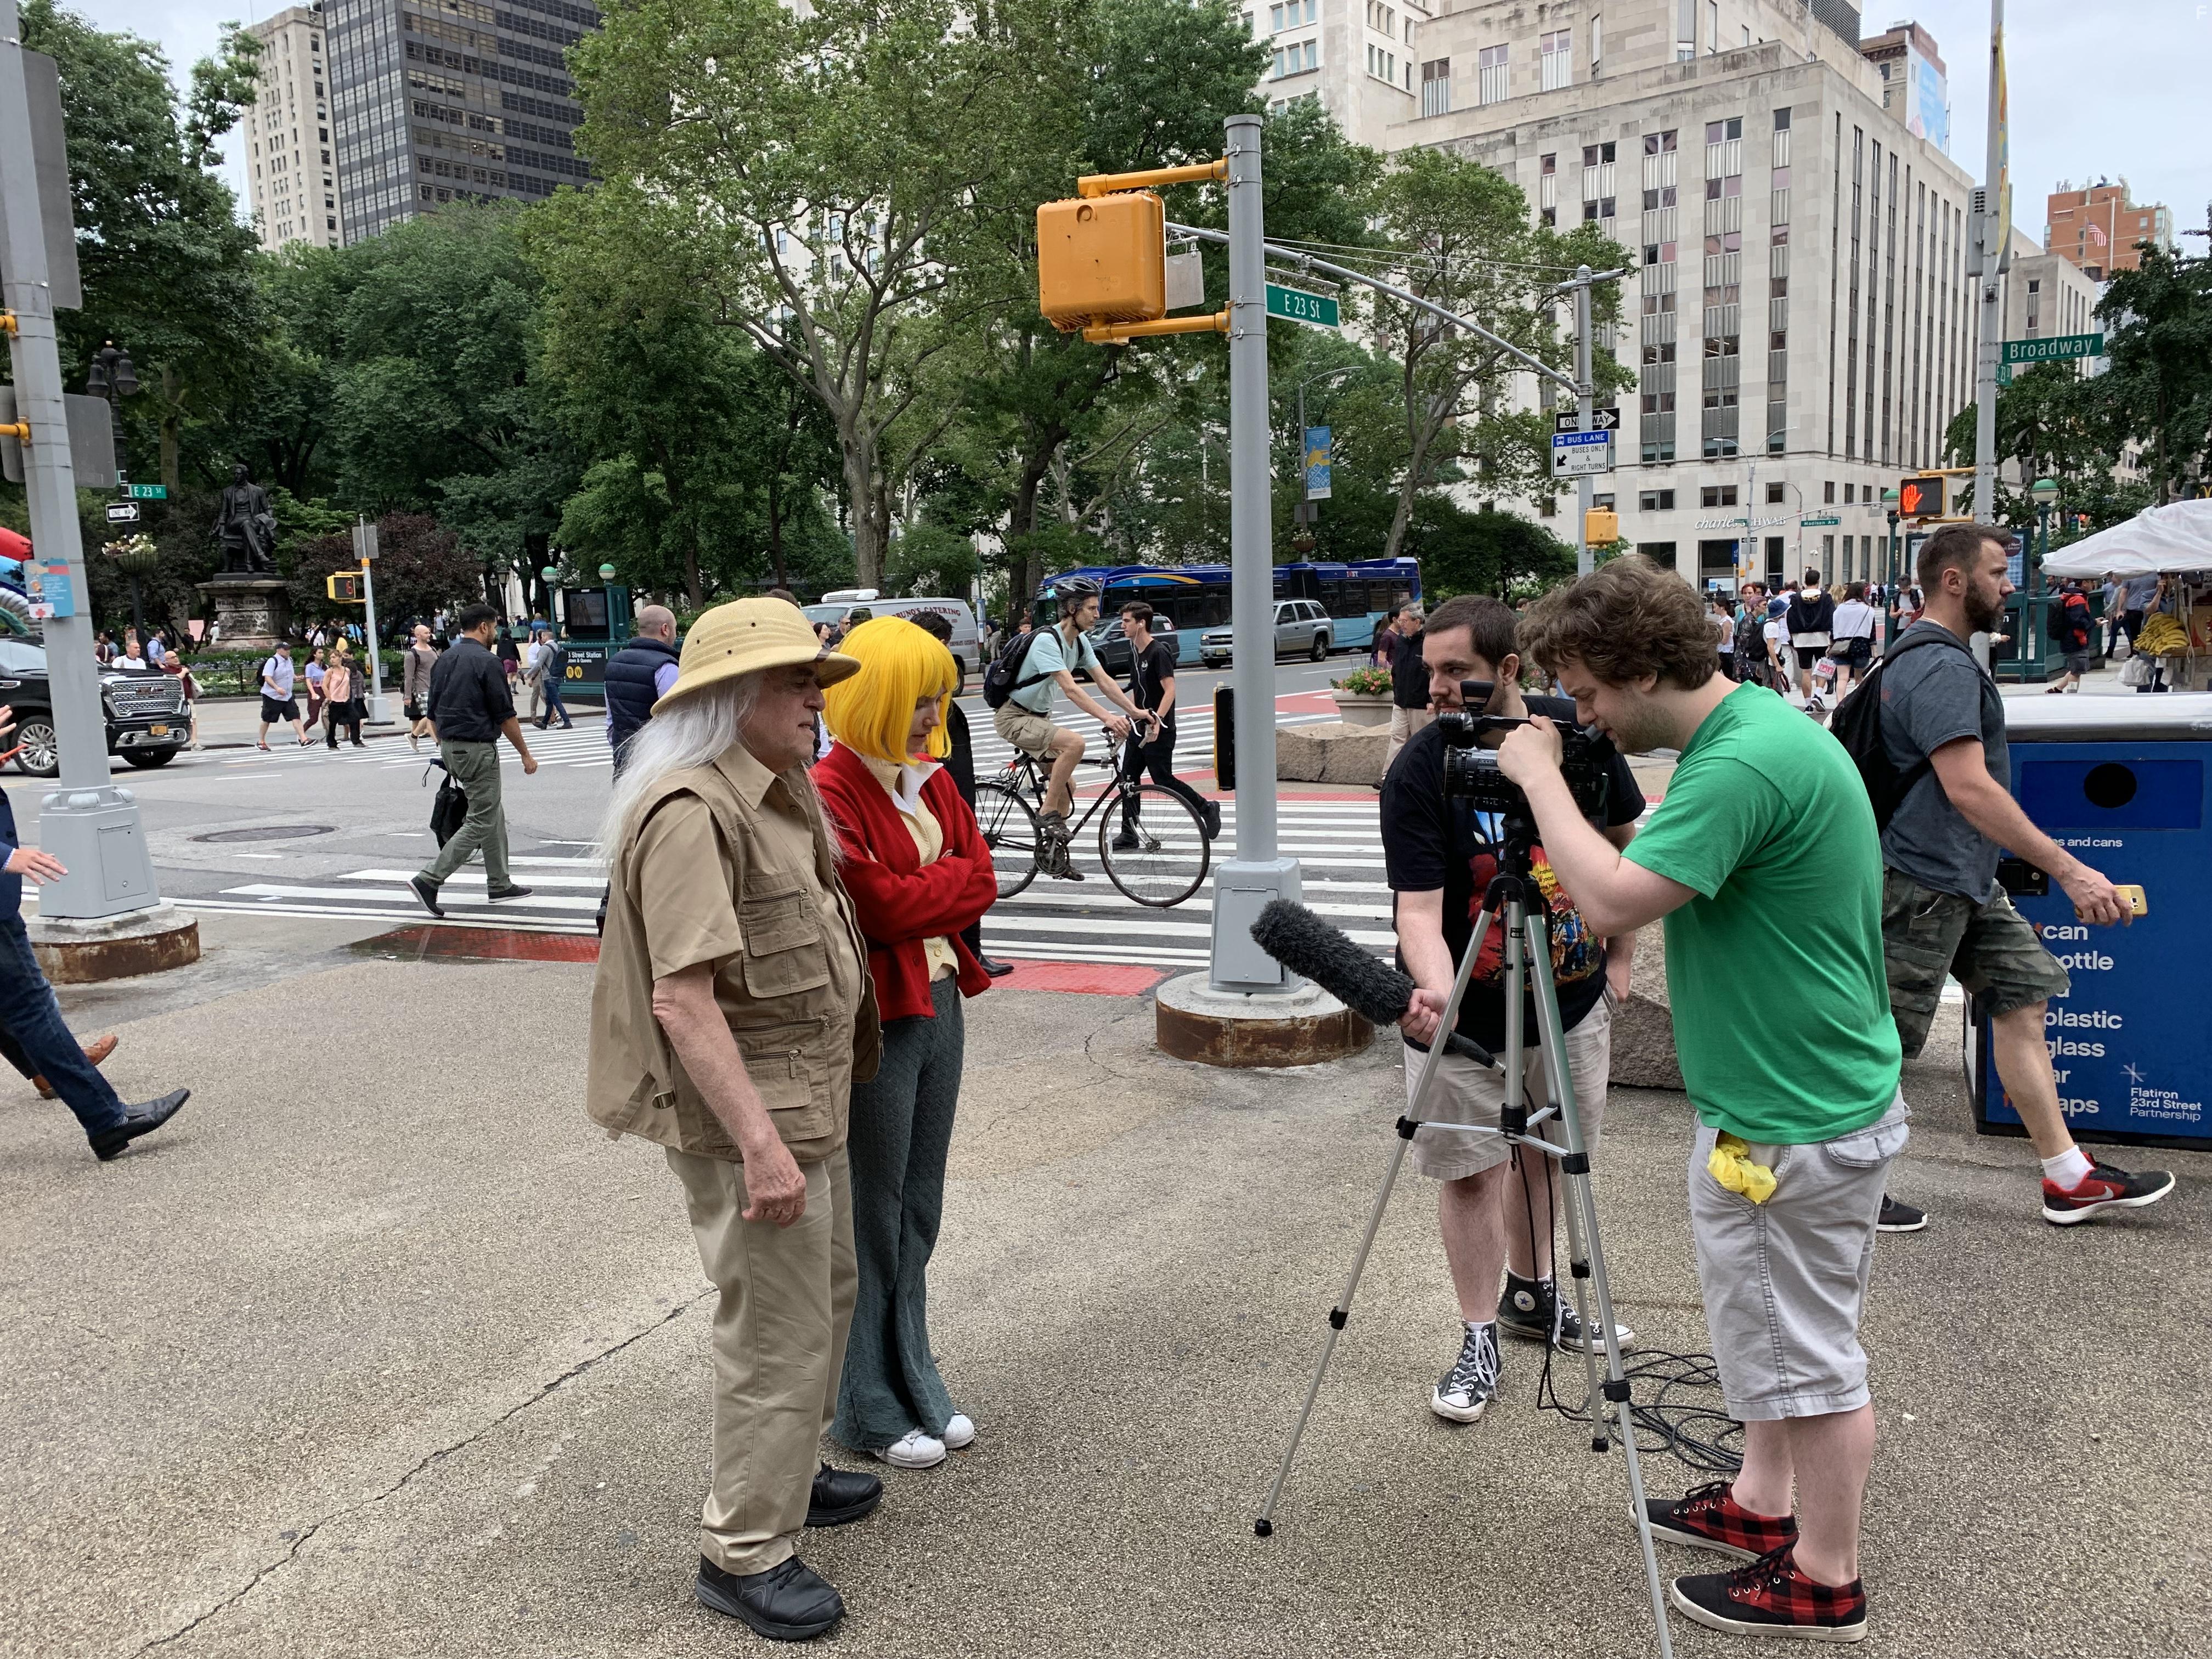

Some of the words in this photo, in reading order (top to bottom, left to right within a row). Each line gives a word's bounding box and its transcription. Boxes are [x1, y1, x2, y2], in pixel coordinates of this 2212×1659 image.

[1284, 294, 1290, 312] E
[1294, 296, 1306, 316] 23
[1310, 300, 1321, 319] St
[2010, 338, 2093, 359] Broadway
[1593, 415, 1610, 424] WAY
[1567, 436, 1582, 444] BUS
[1584, 434, 1605, 442] LANE
[1572, 446, 1589, 454] BUSES
[1591, 444, 1605, 453] ONLY
[133, 486, 139, 496] E
[142, 486, 153, 497] 23
[1738, 516, 1787, 527] HWAB
[891, 607, 921, 618] RUNO'S
[924, 607, 961, 616] CATERING
[2067, 837, 2091, 847] and
[2092, 839, 2123, 847] cans
[2043, 925, 2088, 940] can
[2044, 1007, 2123, 1031] plastic
[2045, 1036, 2106, 1059] glass
[2053, 1069, 2071, 1084] ar
[2131, 1087, 2179, 1099] Flatiron
[2058, 1097, 2100, 1118] aps
[2131, 1097, 2160, 1108] 23rd
[2163, 1099, 2202, 1111] Street
[2130, 1107, 2201, 1123] Partnership
